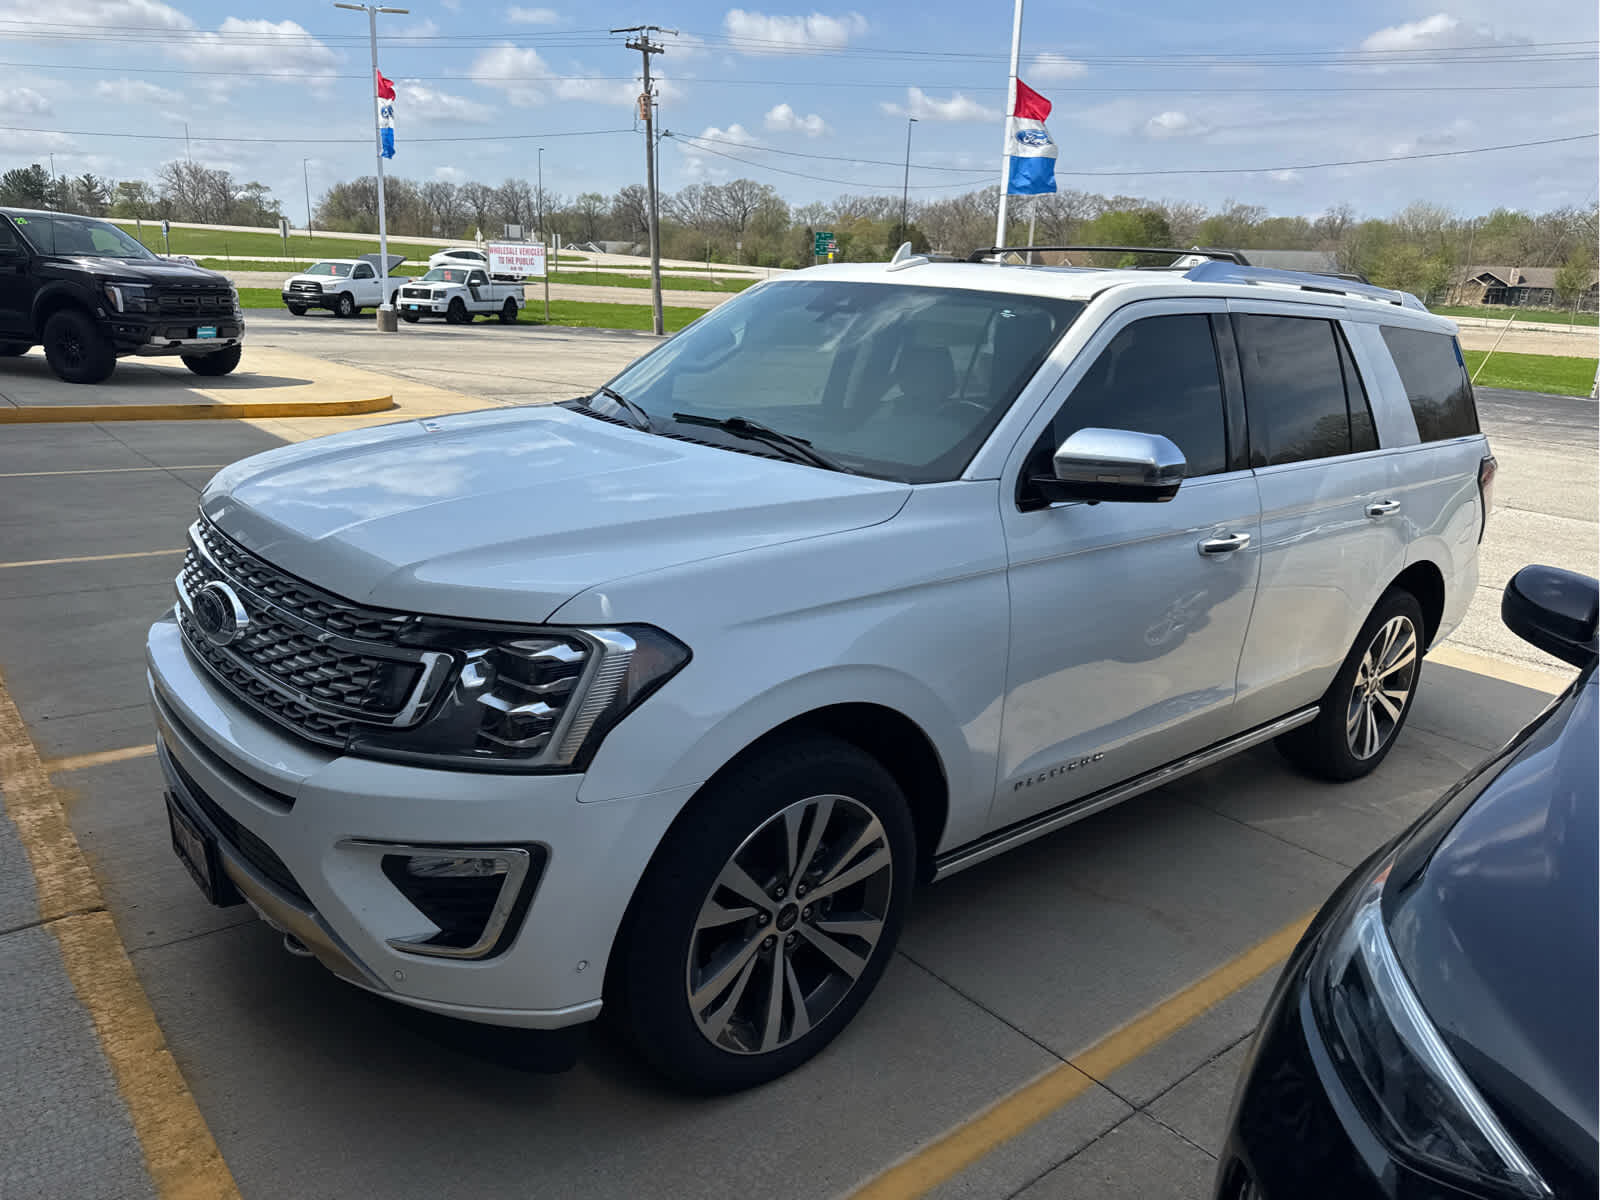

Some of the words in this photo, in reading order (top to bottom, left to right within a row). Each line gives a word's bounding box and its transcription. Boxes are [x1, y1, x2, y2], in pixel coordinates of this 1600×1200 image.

[488, 247, 517, 255] WHOLESALE
[519, 247, 545, 256] VEHICLES
[498, 256, 505, 264] TO
[505, 256, 514, 264] THE
[1013, 752, 1104, 792] PLATINUM
